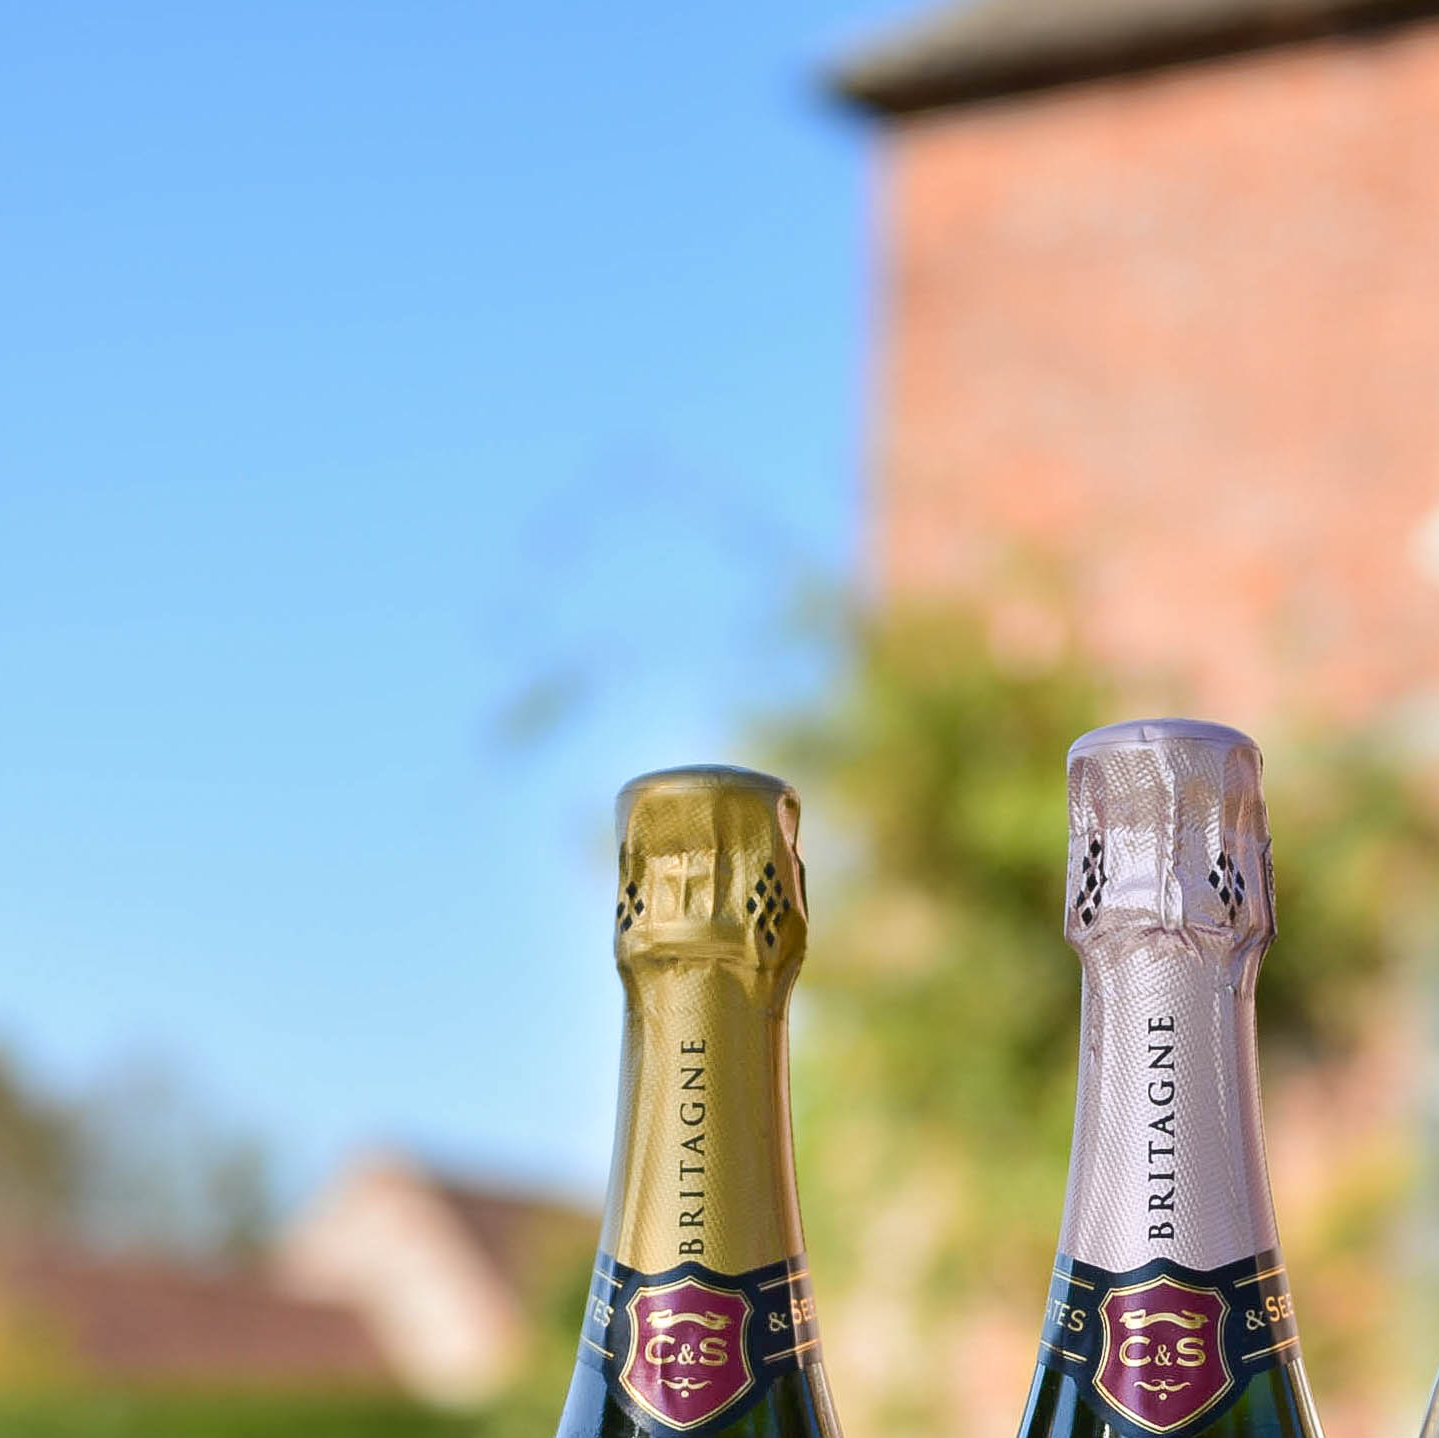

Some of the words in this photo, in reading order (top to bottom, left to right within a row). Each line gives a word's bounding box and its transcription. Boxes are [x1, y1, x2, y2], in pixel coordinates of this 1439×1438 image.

[1148, 1015, 1175, 1241] BRITAGNE
[678, 1038, 706, 1256] BRITAGNE
[768, 1311, 790, 1332] &
[1245, 1309, 1266, 1331] &
[644, 1334, 729, 1367] C&S
[1119, 1336, 1207, 1368] C&S
